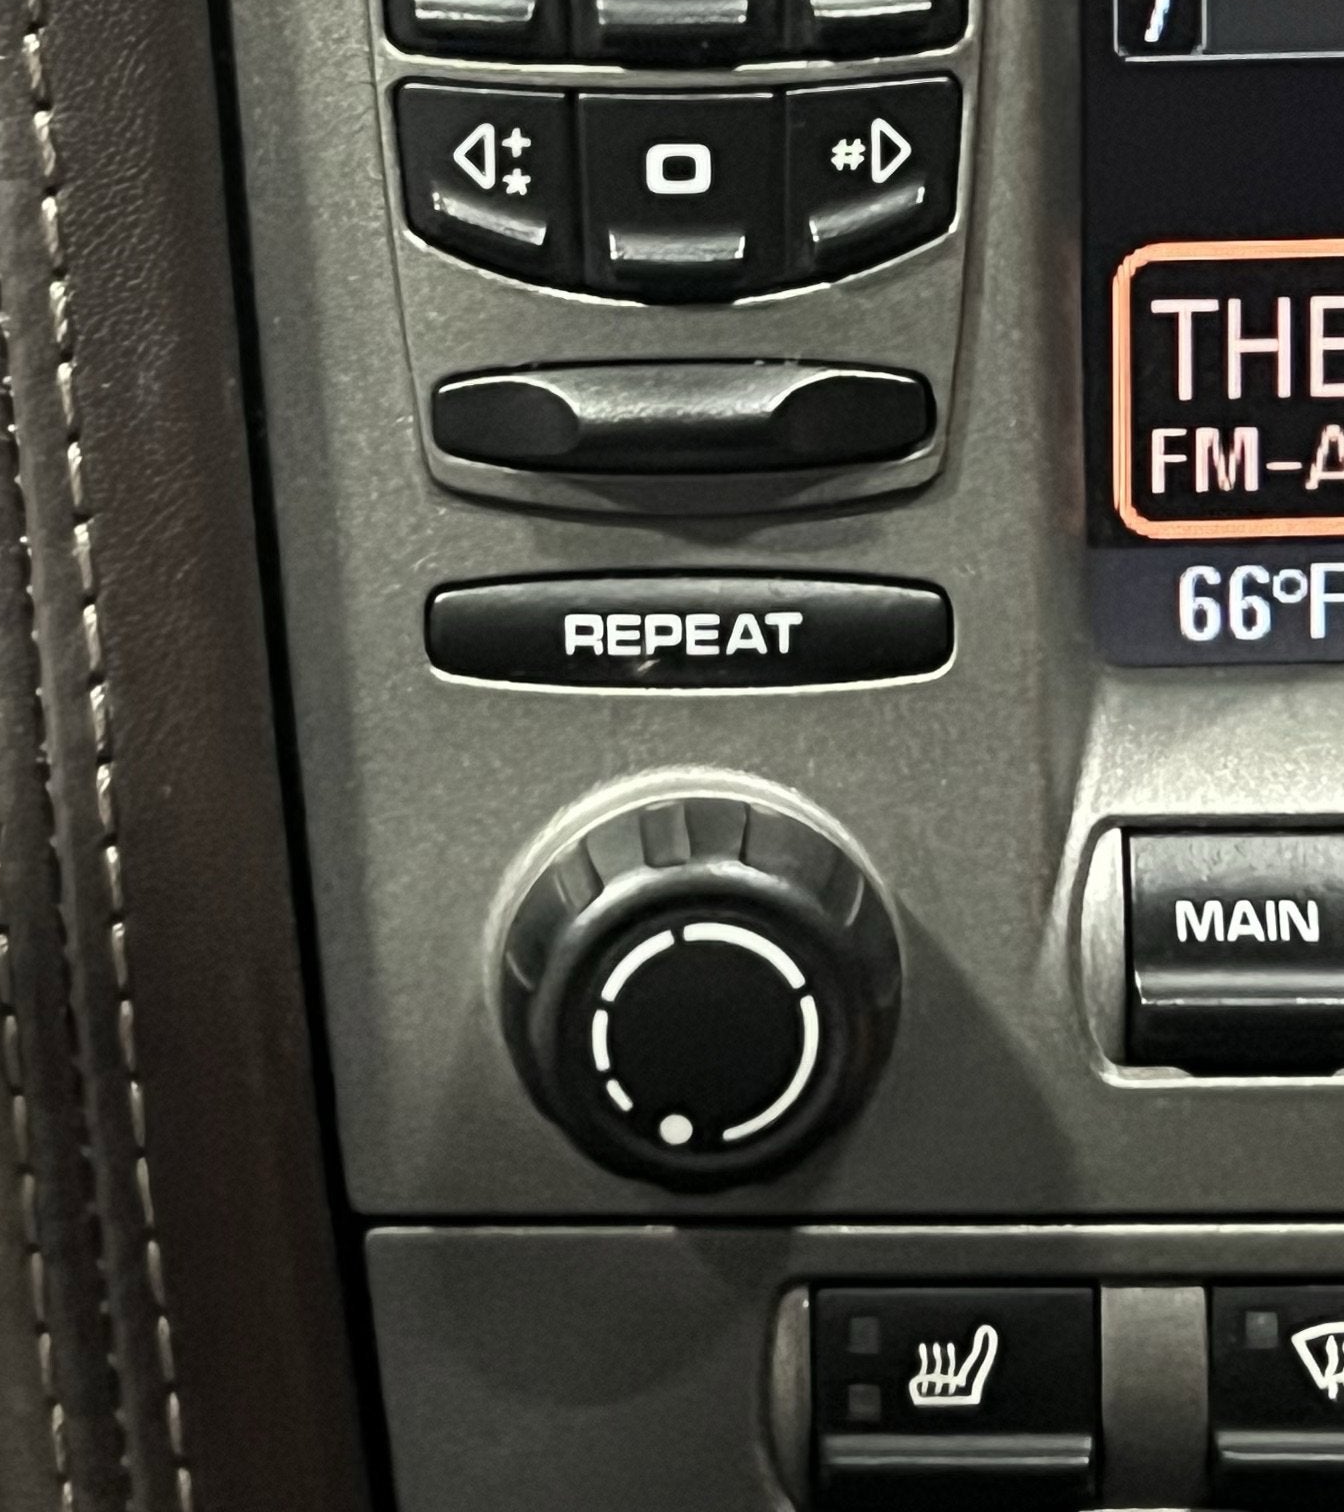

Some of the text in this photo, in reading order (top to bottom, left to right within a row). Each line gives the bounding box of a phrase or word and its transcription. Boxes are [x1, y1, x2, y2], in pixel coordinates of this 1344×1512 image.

[645, 143, 712, 195] 0
[564, 611, 804, 656] REPEAT
[1175, 899, 1320, 943] MAIN
